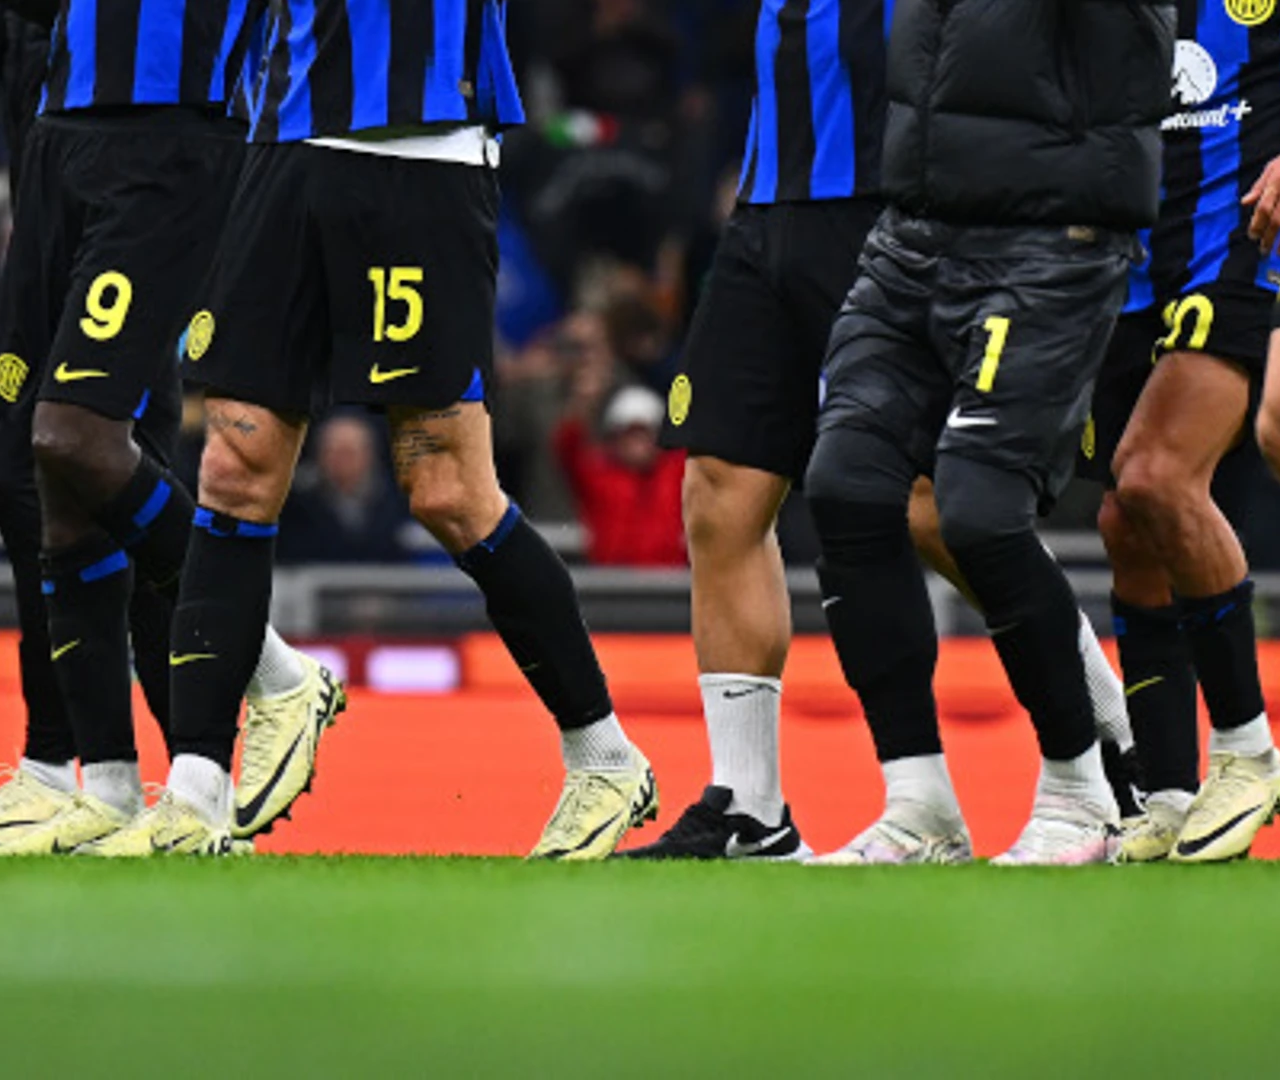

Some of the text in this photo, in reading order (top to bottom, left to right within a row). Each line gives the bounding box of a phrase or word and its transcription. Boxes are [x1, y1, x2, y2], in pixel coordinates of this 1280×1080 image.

[80, 271, 132, 340] 9
[368, 267, 423, 341] 15
[975, 315, 1010, 392] 1
